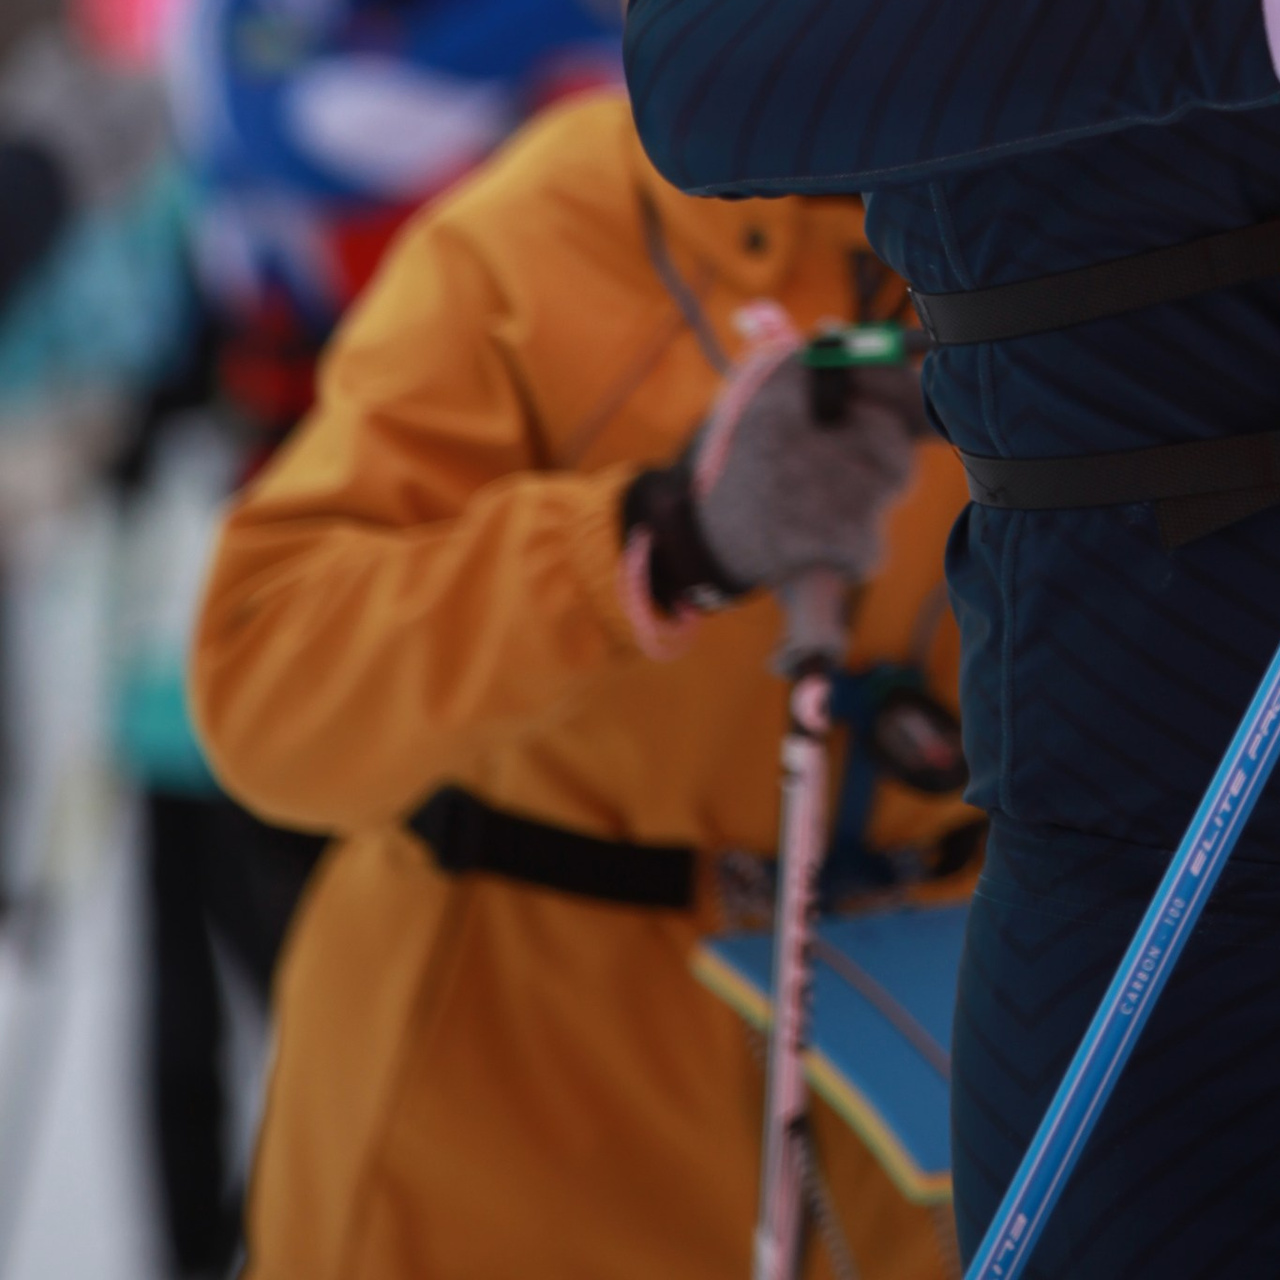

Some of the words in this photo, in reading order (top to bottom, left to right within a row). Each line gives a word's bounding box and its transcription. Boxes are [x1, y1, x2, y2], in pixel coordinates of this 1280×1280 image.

[1119, 945, 1162, 1016] CARBON
[1163, 896, 1186, 927] 100
[1190, 767, 1248, 877] ELITE
